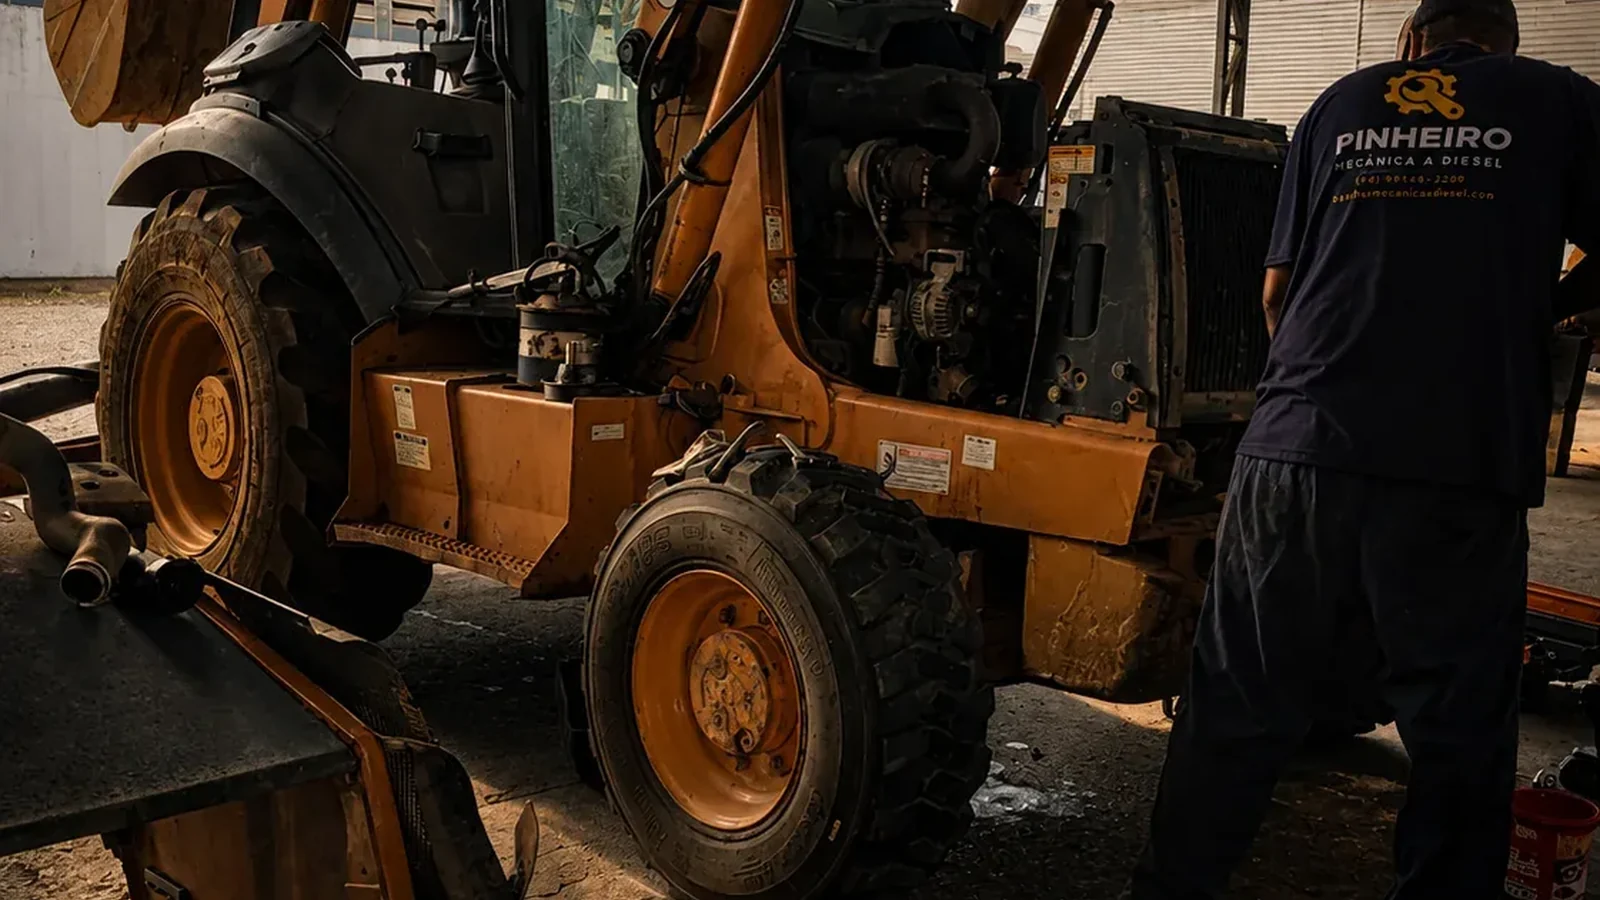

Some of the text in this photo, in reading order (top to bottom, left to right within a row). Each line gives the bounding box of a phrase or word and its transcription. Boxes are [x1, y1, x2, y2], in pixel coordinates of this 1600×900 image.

[1336, 126, 1512, 155] PINHEIRO
[1423, 156, 1434, 166] A
[1442, 155, 1502, 168] DIESEL
